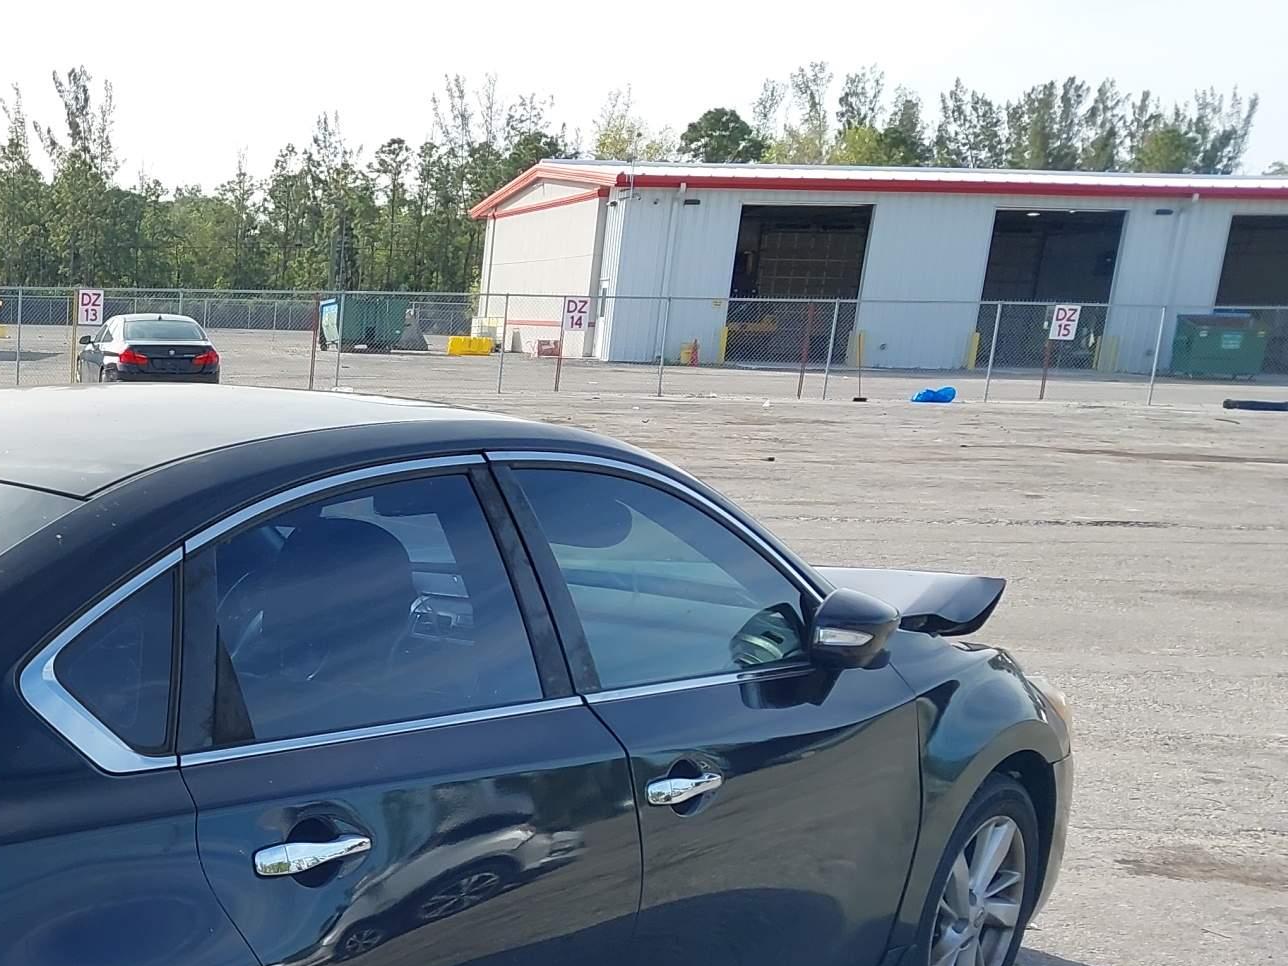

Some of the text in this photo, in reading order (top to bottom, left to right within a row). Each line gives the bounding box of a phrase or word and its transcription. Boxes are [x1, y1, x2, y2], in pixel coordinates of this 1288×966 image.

[81, 293, 101, 307] DZ
[567, 299, 588, 314] DZ
[84, 308, 98, 322] 13
[570, 315, 583, 329] 14
[1055, 308, 1078, 322] DZ
[1057, 324, 1071, 337] 15
